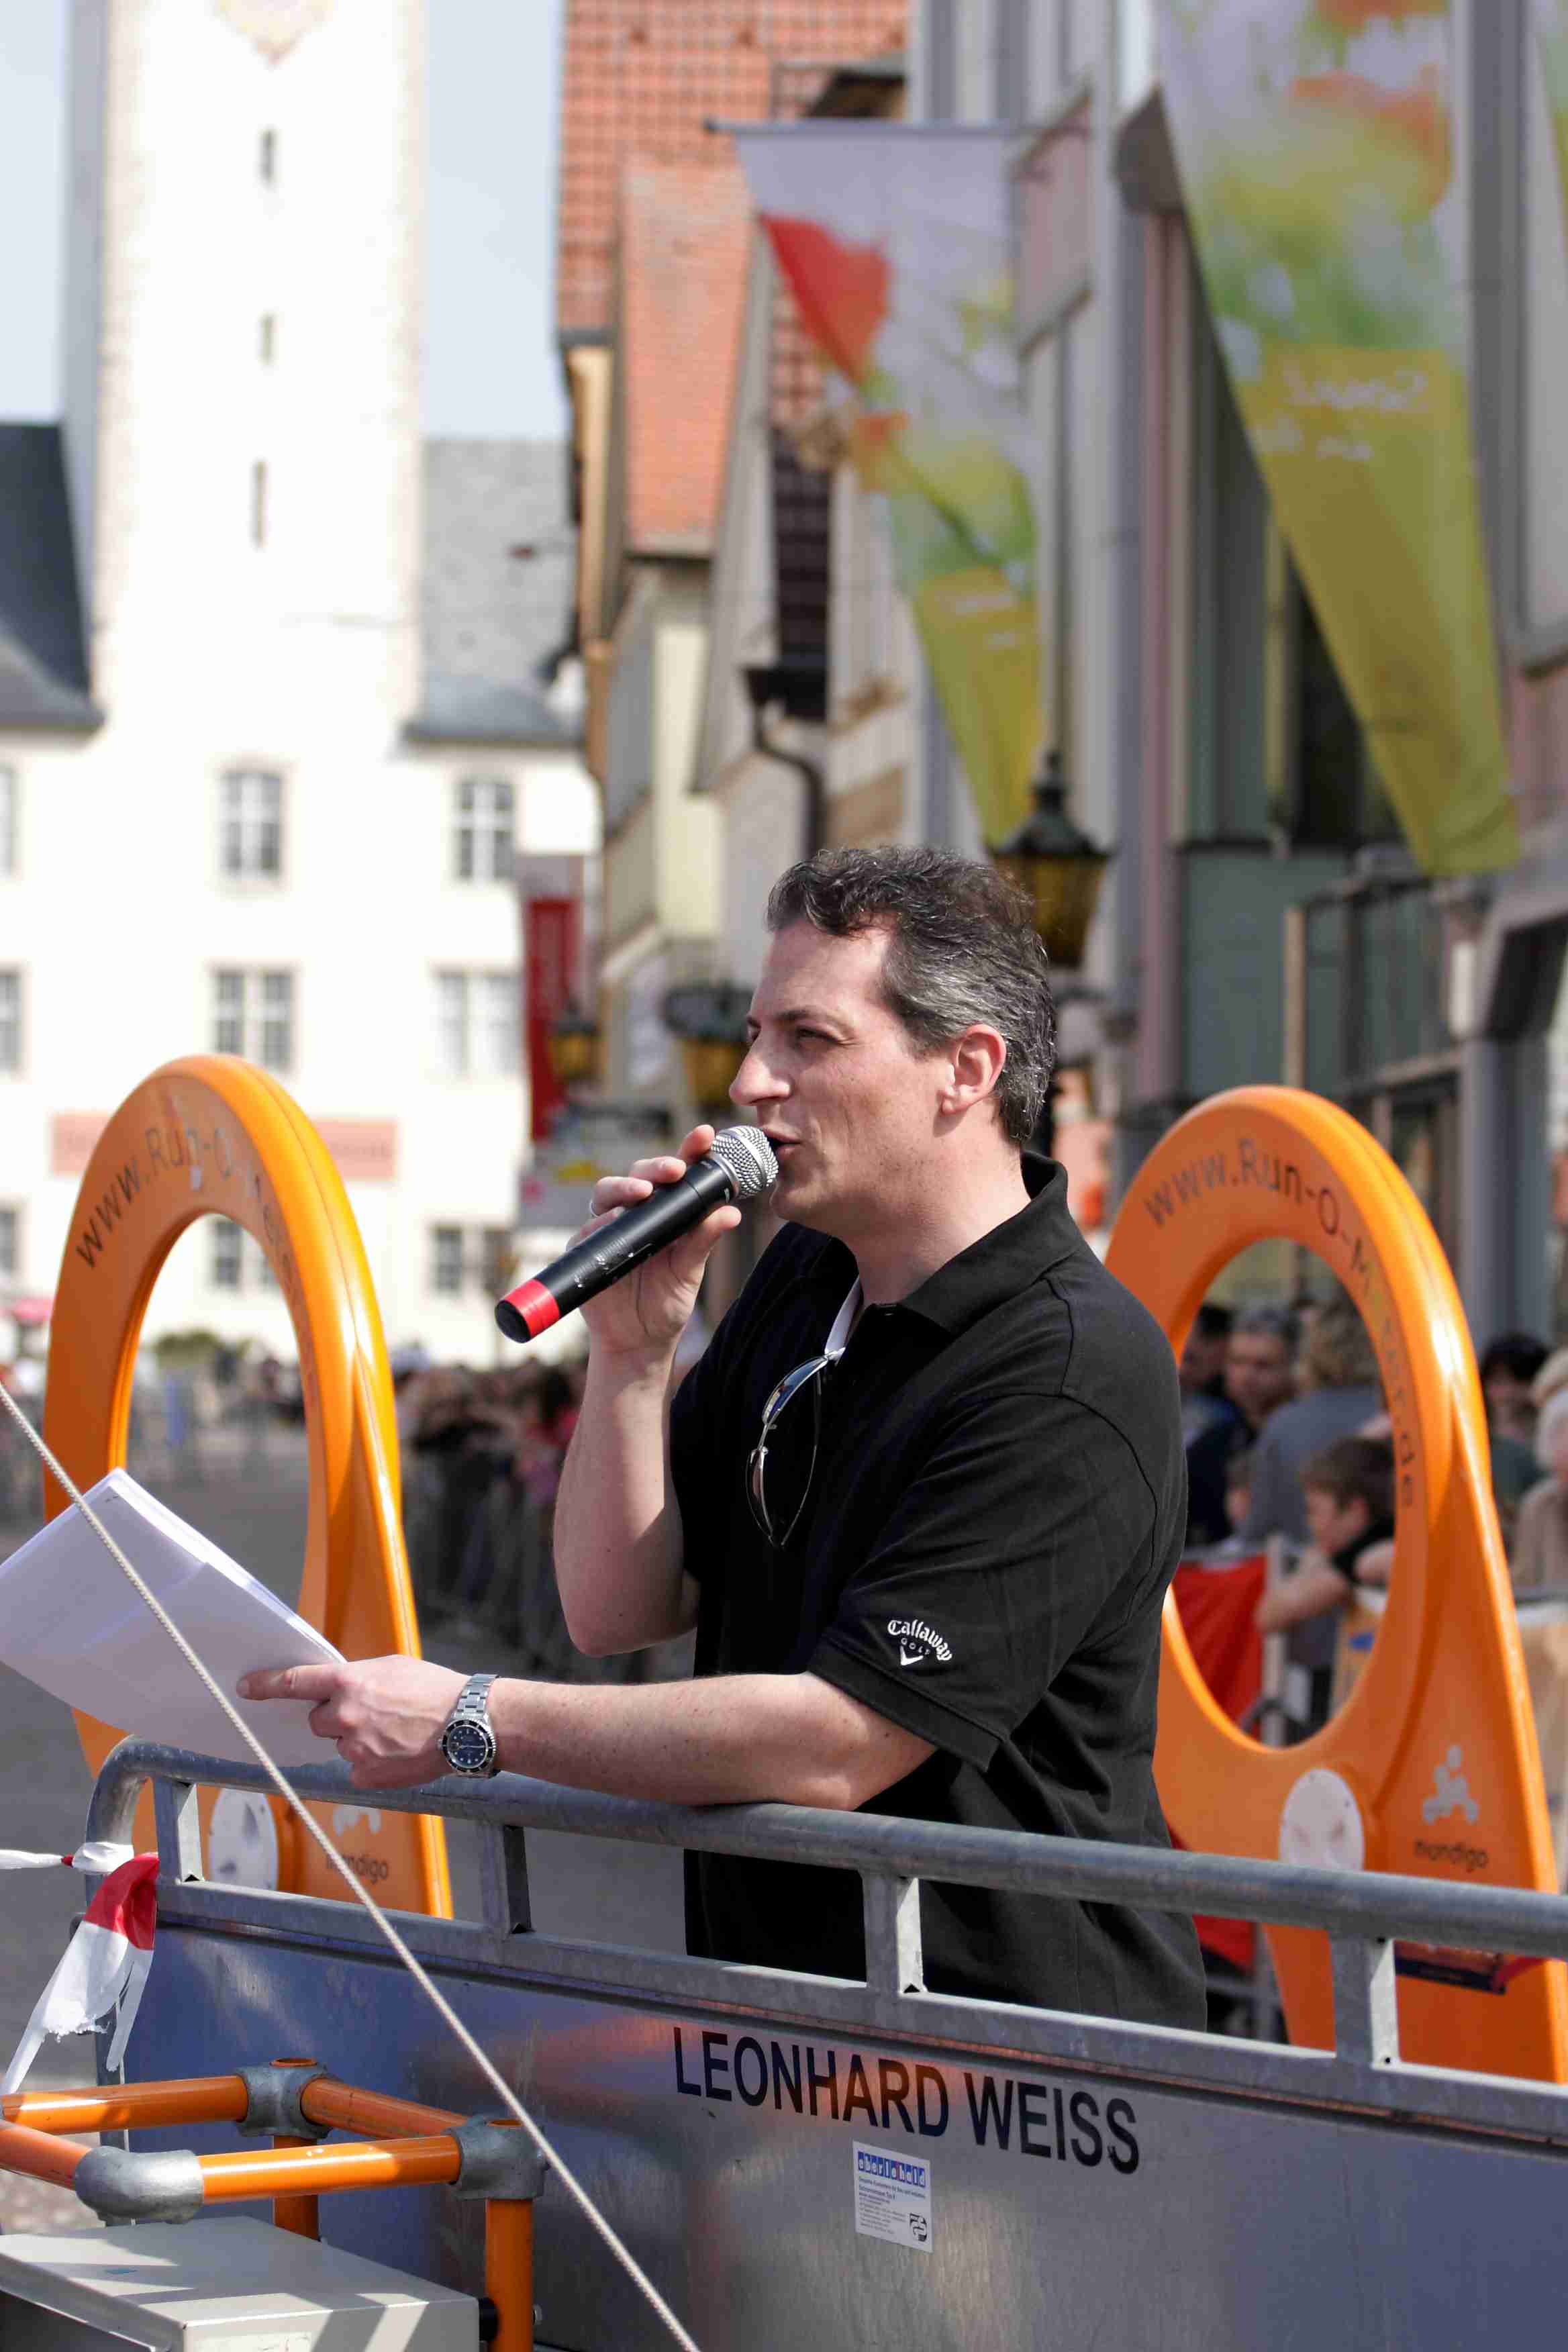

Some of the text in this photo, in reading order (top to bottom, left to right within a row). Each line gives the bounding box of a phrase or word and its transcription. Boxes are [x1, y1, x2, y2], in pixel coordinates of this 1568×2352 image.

[887, 1619, 952, 1661] Callaway
[673, 2027, 1139, 2174] LEONHARD WEISS
